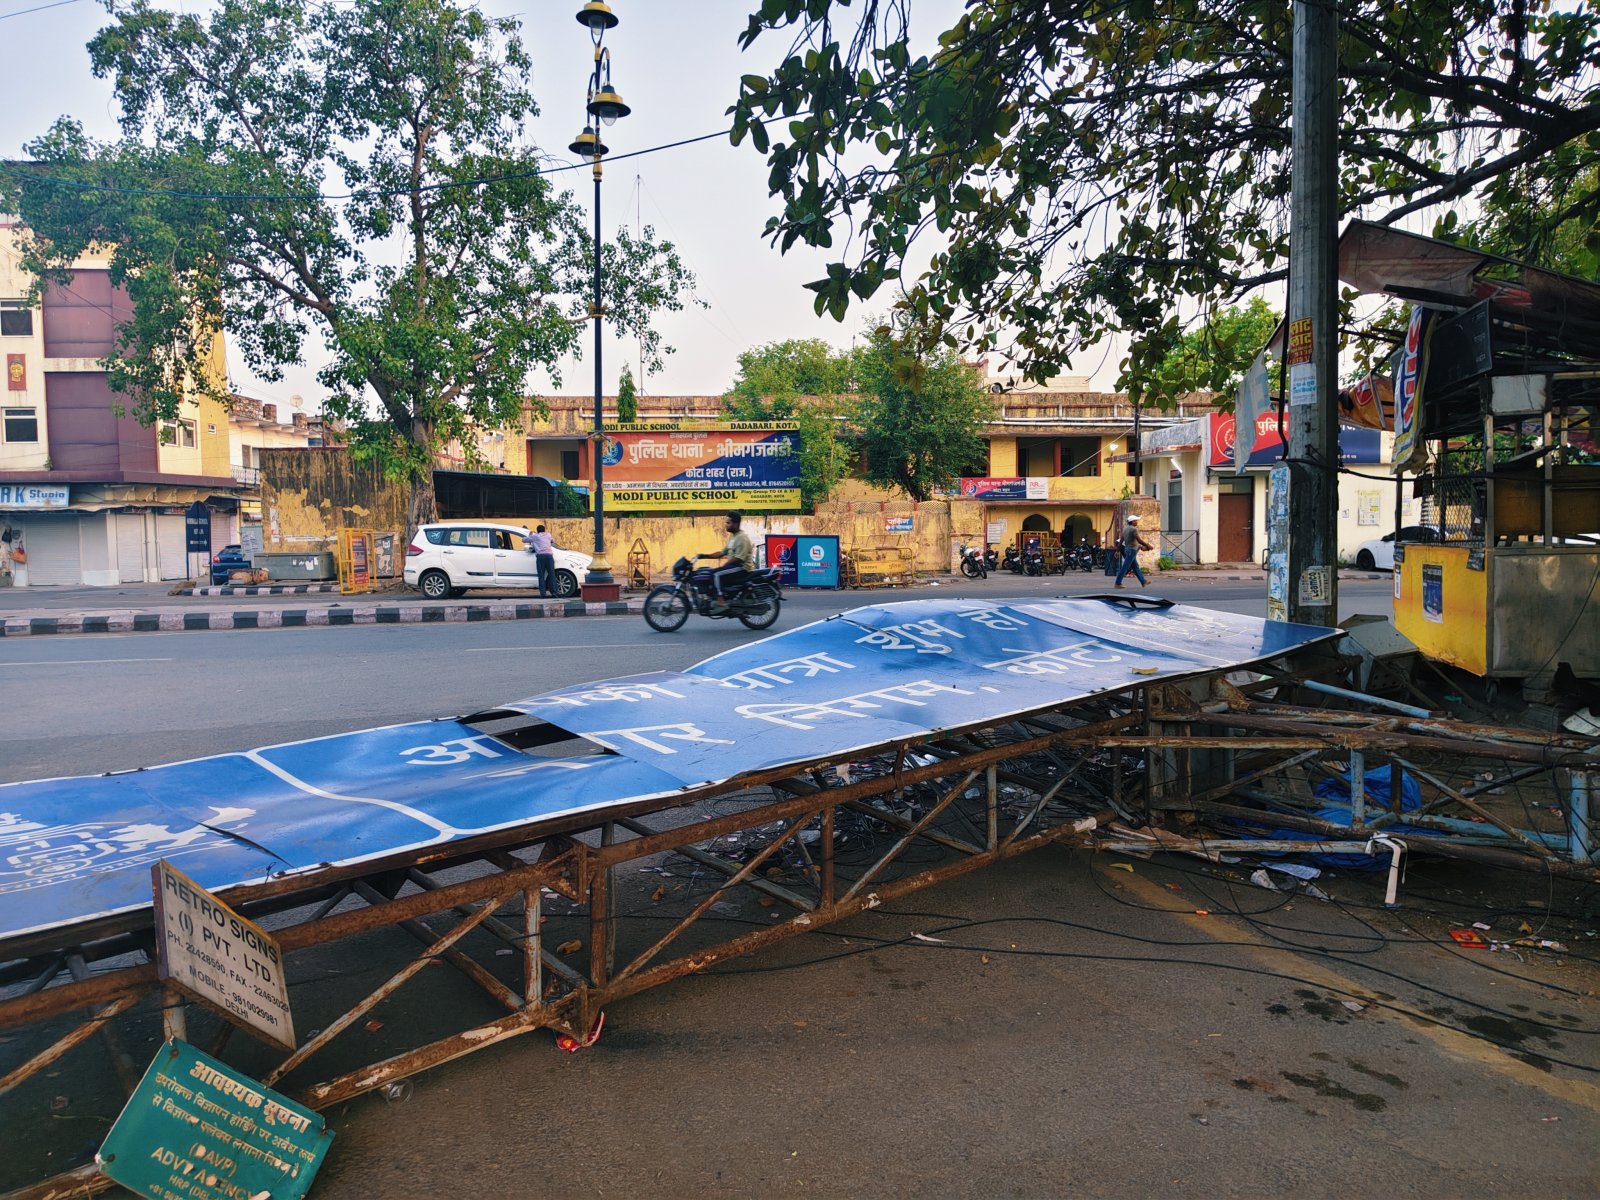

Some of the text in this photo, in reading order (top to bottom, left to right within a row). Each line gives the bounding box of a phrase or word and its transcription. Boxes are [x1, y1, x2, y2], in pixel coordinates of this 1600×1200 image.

[620, 423, 648, 431] PUBLIC
[628, 440, 669, 463] पुलिस
[671, 442, 705, 458] थाना
[716, 438, 794, 458] भीमगंजमंडी
[685, 464, 753, 479] कोटा शहर (राज.)
[29, 489, 65, 498] Studio
[613, 489, 739, 501] MODI PUBLIC SCHOOL
[853, 619, 967, 655] शुभ
[981, 640, 1143, 676] कोटा
[165, 871, 278, 965] RETRO SIGNS
[167, 929, 183, 949] PH.
[230, 969, 247, 989] FAX
[179, 910, 276, 987] (I) PVT. LTD.
[188, 964, 225, 993] MOBILE
[232, 991, 278, 1027] 9810029981
[224, 997, 249, 1020] DELHI
[189, 1059, 312, 1135] आवश्यक सूचना
[151, 1093, 163, 1107] से
[232, 1137, 265, 1164] लगाना
[193, 1090, 231, 1121] विज्ञापन
[257, 1126, 271, 1143] पर
[271, 1130, 298, 1155] अवैध
[168, 1174, 190, 1191] HRP
